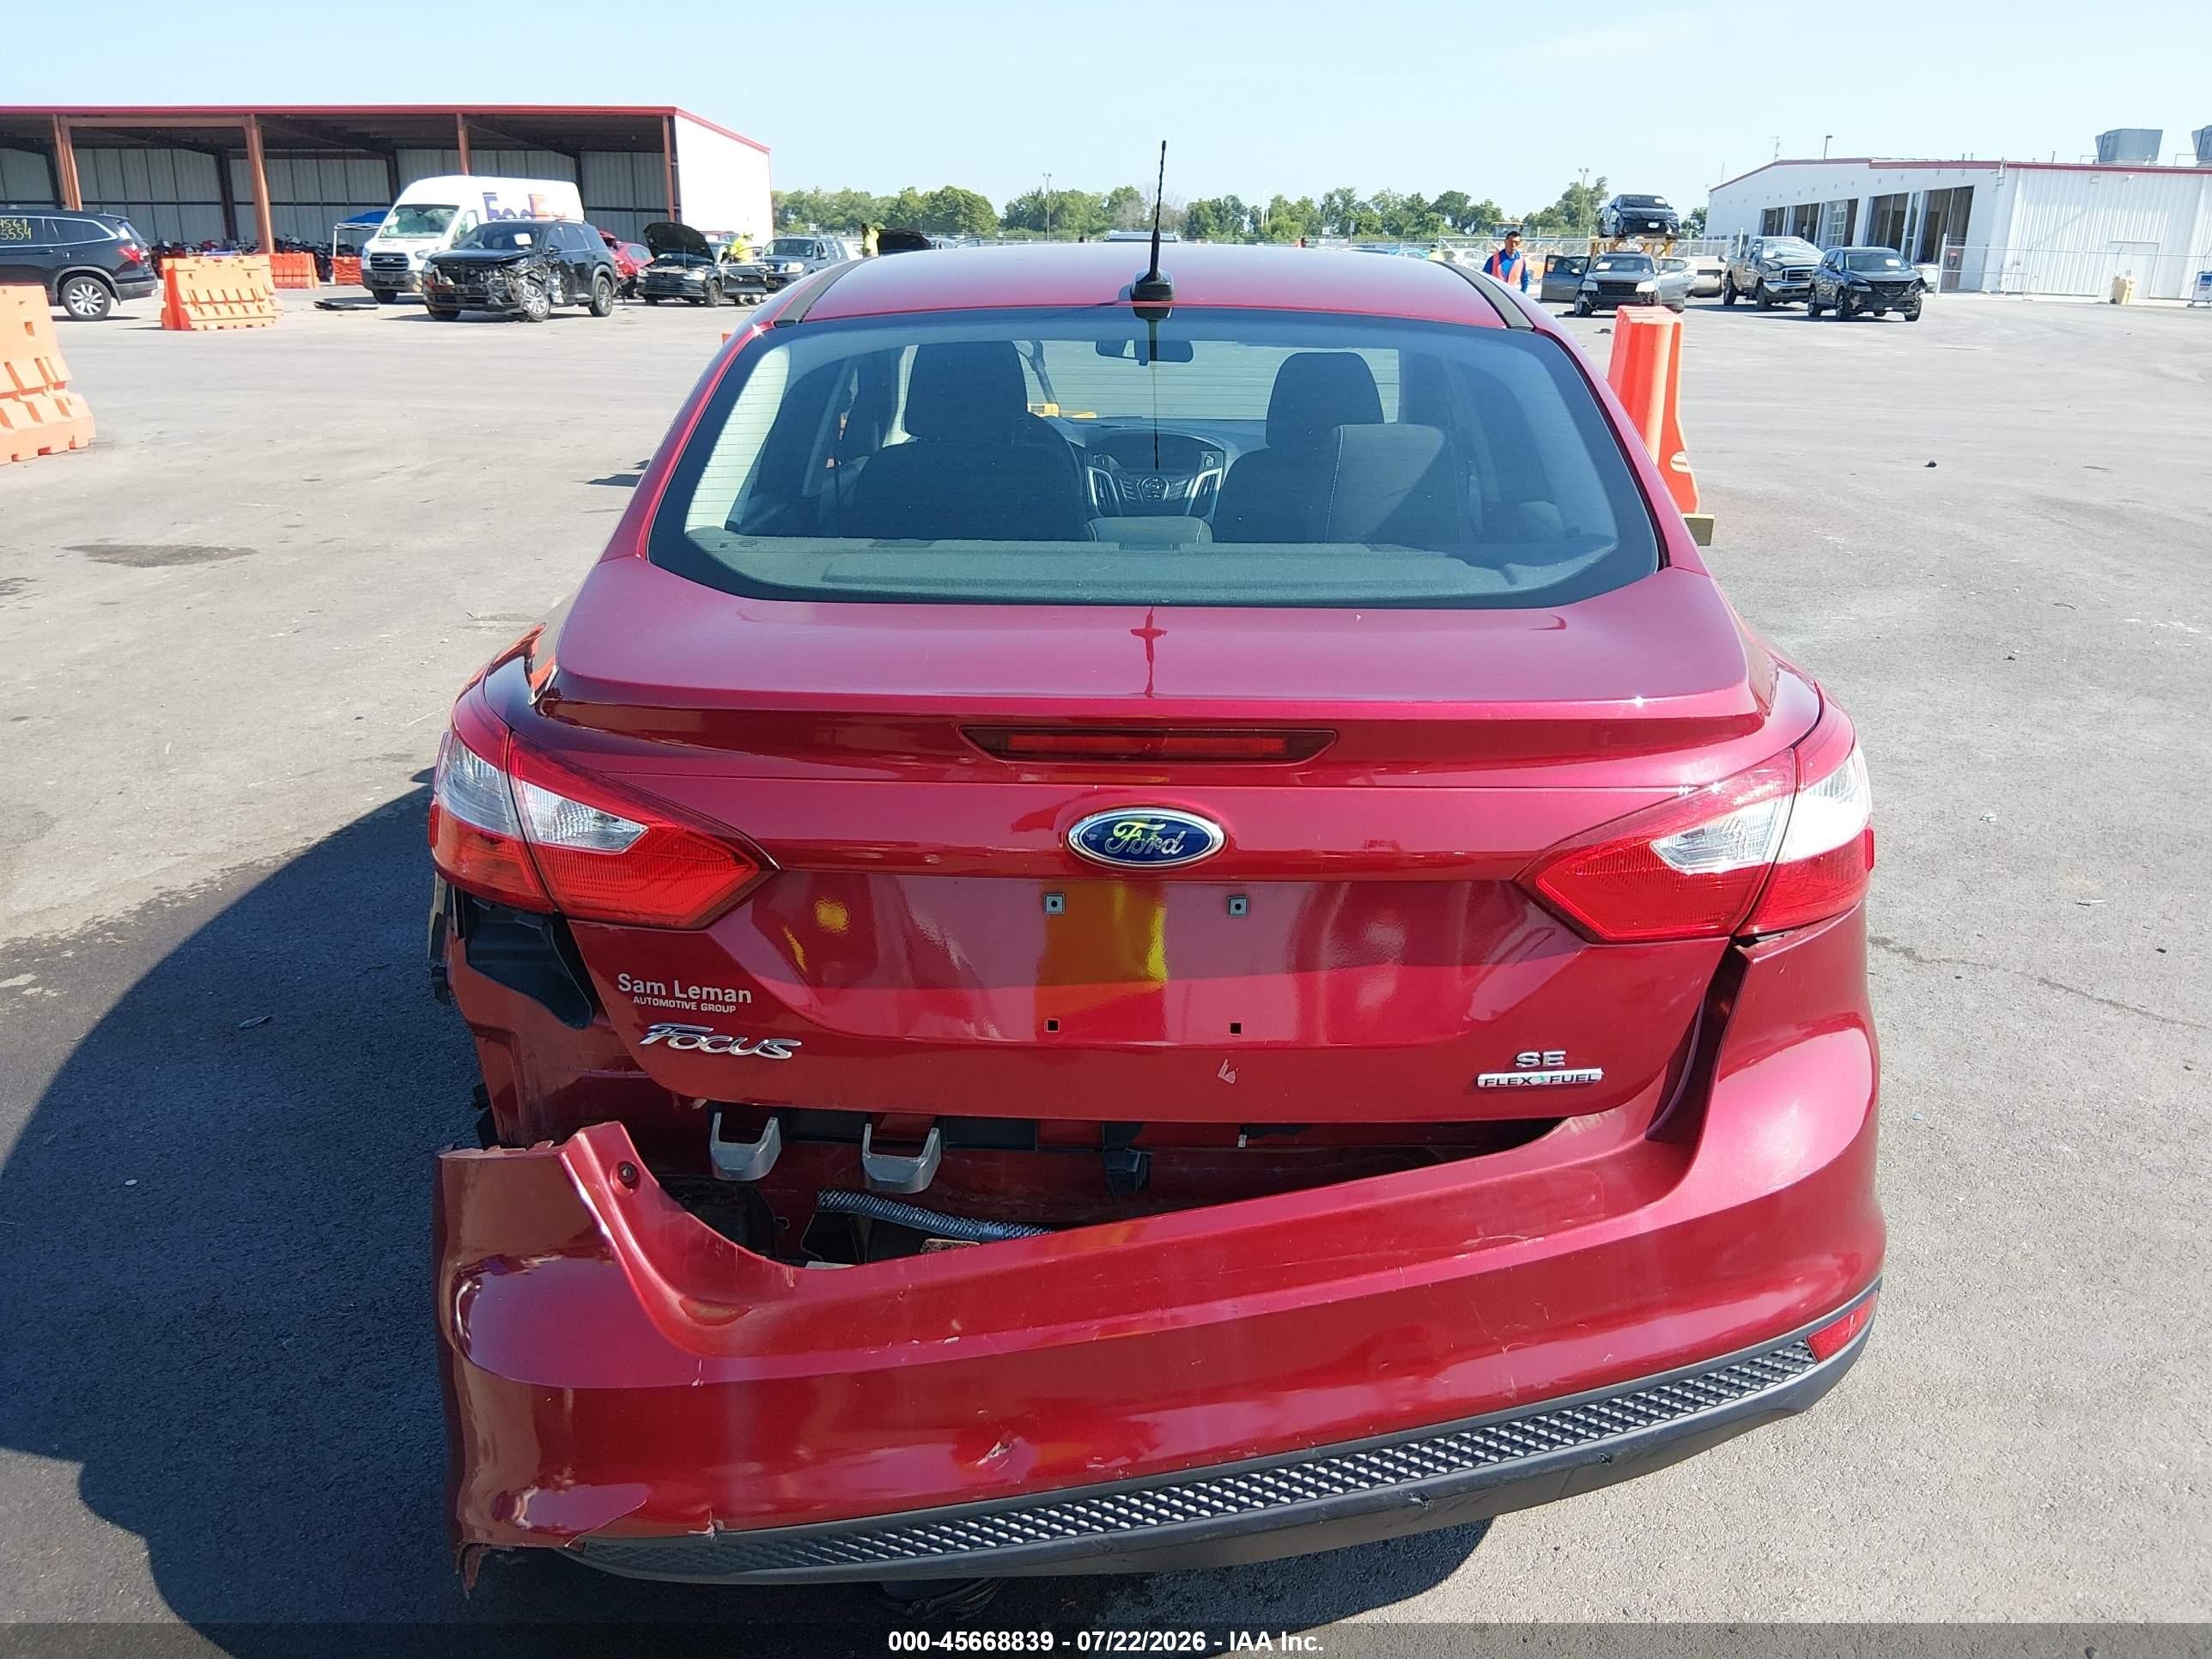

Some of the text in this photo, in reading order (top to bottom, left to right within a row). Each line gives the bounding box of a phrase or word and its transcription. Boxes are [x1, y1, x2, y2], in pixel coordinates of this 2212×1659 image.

[1104, 821, 1184, 855] Ford
[617, 973, 752, 1004] Sam Leman
[632, 995, 737, 1014] AUTOMOTIVE GROUP
[1515, 1049, 1567, 1068] SE
[1484, 1073, 1599, 1087] FLEX FUEL
